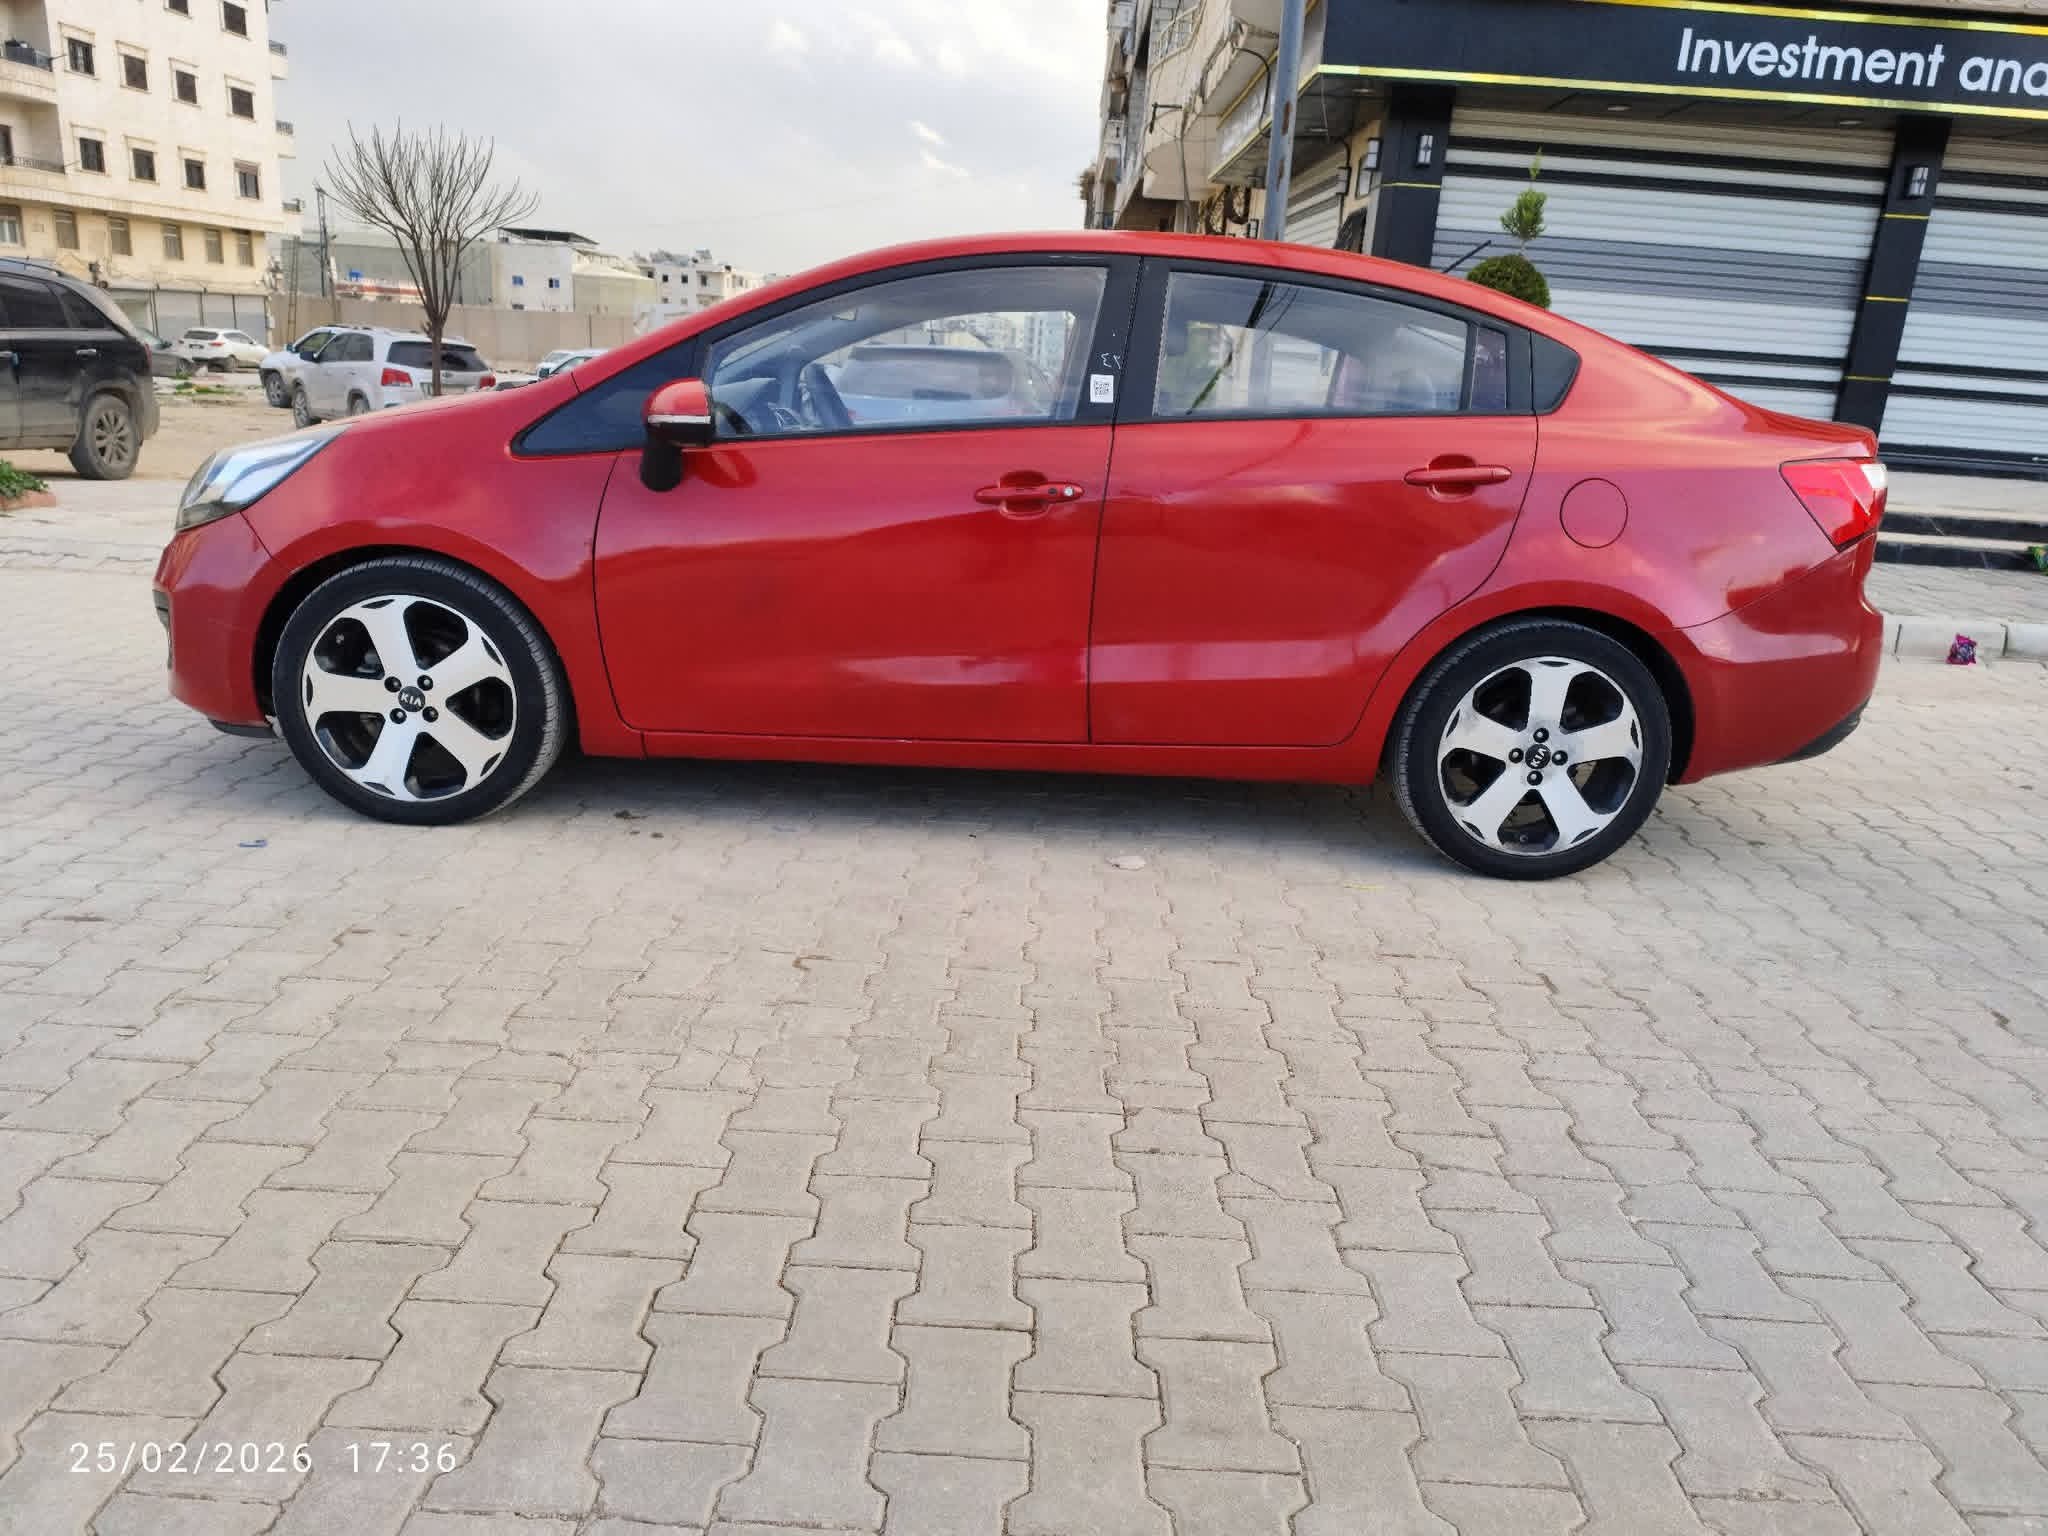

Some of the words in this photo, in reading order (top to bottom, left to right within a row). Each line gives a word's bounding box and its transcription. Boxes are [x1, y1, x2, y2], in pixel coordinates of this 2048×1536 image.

[1676, 27, 1945, 88] Investment
[401, 693, 422, 707] KIA
[1530, 748, 1547, 768] KIA
